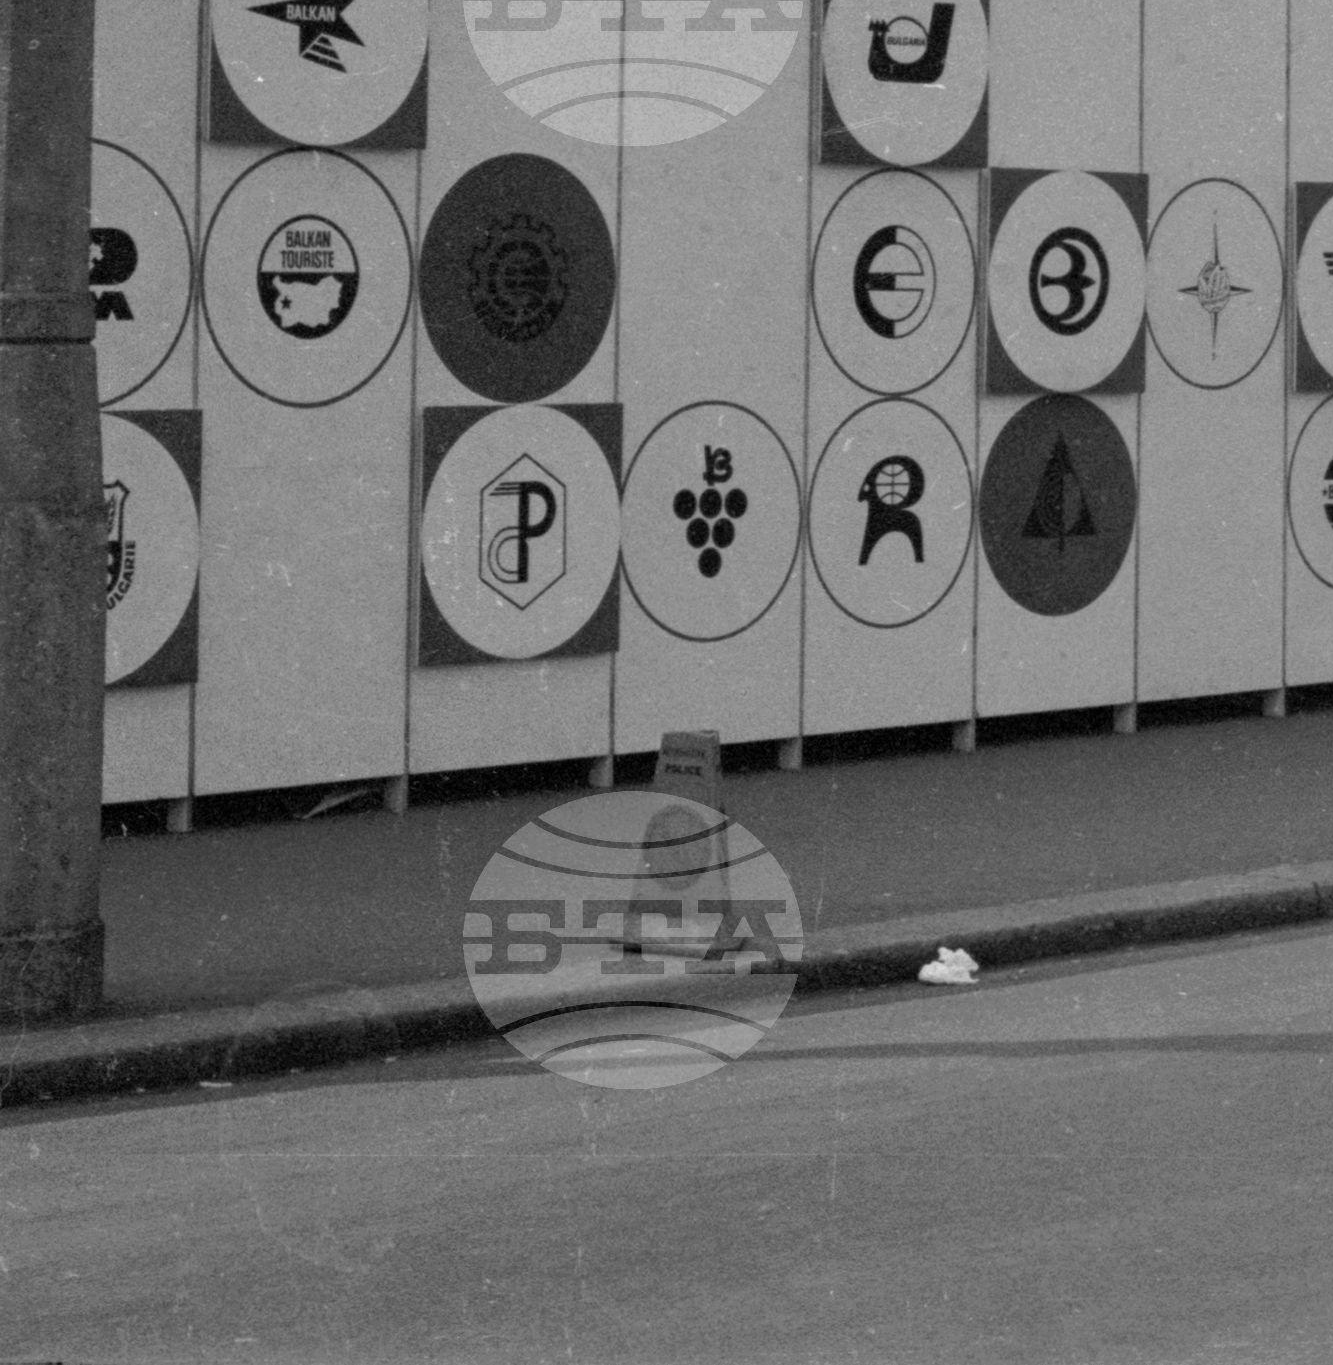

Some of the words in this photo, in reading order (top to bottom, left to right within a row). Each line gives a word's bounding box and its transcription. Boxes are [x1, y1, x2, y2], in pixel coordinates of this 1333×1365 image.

[286, 4, 336, 22] BALKAN
[285, 230, 331, 247] BALKAN
[280, 250, 335, 268] TOURISTE
[106, 540, 136, 610] ULGARIE
